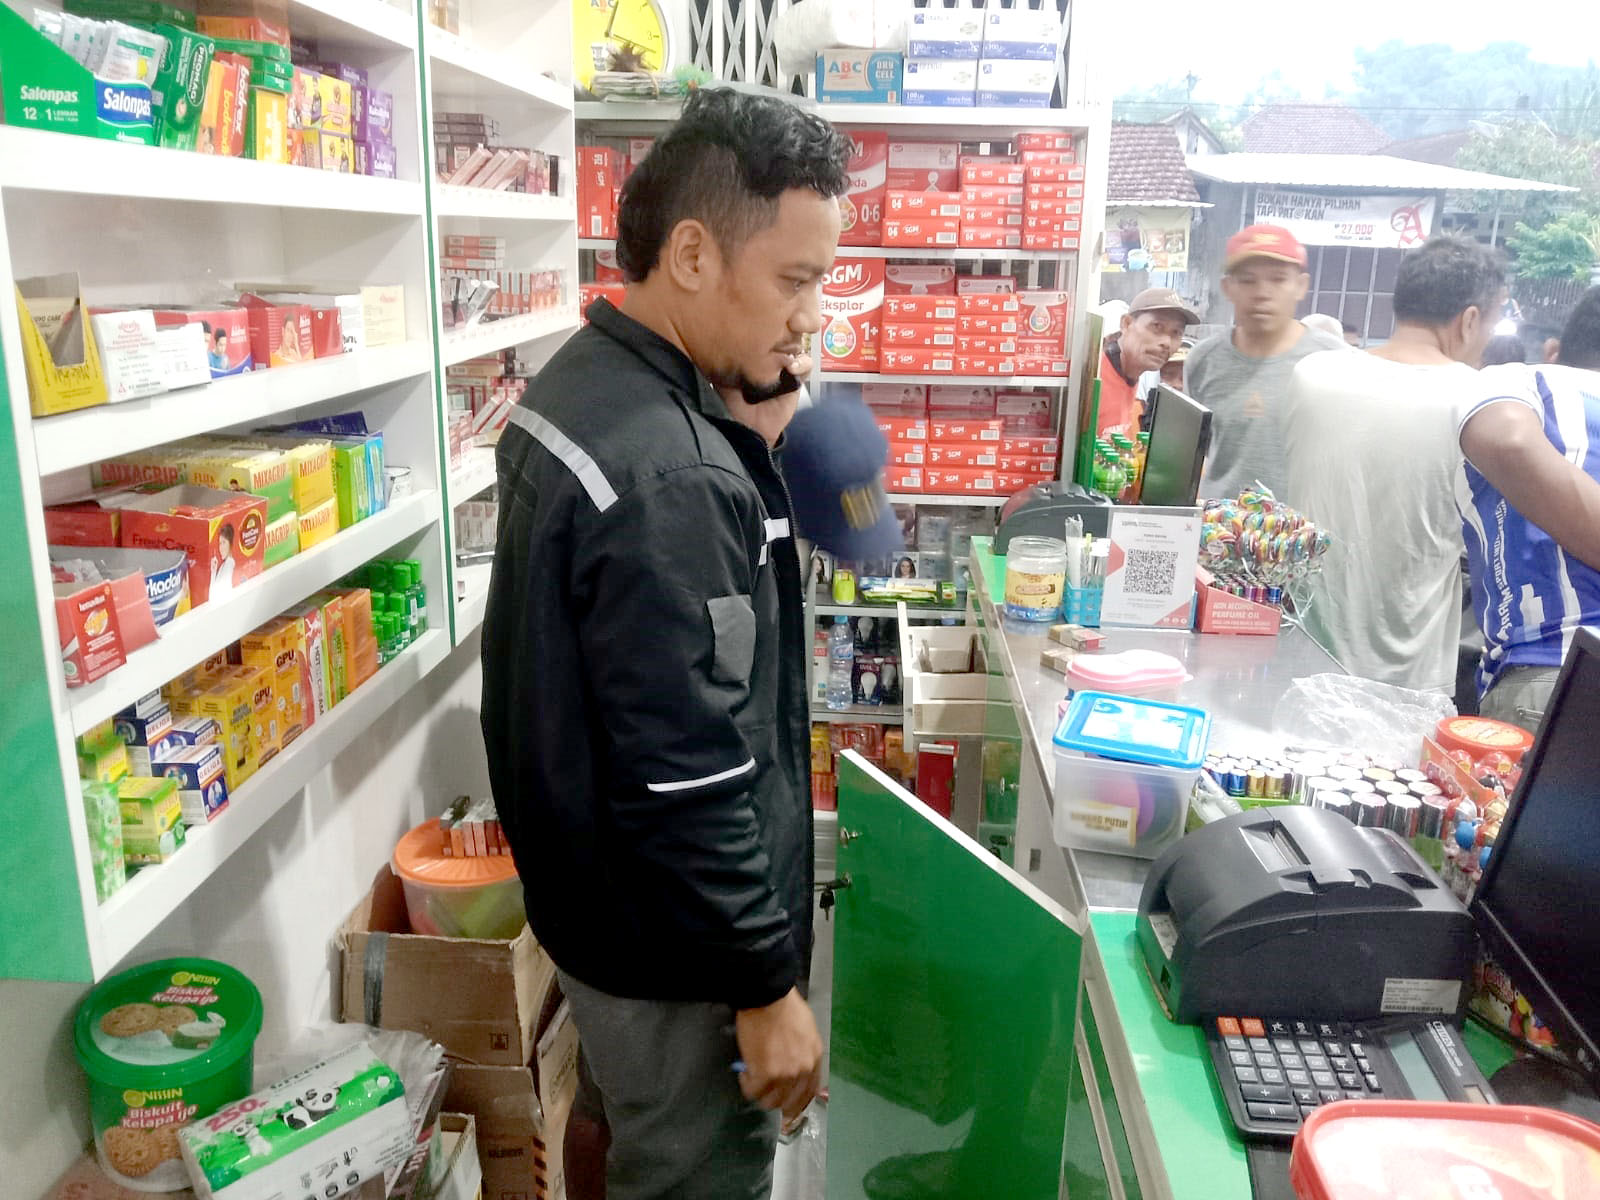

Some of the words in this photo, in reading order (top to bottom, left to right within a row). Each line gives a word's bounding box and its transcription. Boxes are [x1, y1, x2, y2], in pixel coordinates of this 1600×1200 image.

[829, 61, 862, 73] ABC
[20, 85, 79, 104] Salonpas
[104, 88, 151, 118] Salonpas
[235, 65, 249, 135] bodrex
[23, 107, 37, 120] 12
[908, 197, 923, 206] SGM
[1257, 192, 1288, 205] BUKAN
[1291, 195, 1322, 207] HANYA
[1324, 199, 1361, 209] PILIHAN
[1256, 205, 1275, 217] TAPI
[821, 263, 862, 285] SGM
[821, 300, 865, 312] Eksplor
[860, 321, 879, 341] 1+
[299, 452, 328, 478] MIXAGRIP
[101, 463, 177, 486] MIXAGRIP
[253, 463, 287, 490] MIXAGRIP
[300, 509, 331, 533] MIXAGRIP
[265, 524, 290, 549] IXAGRIP
[145, 571, 181, 598] rkadan
[205, 654, 222, 672] GPU
[276, 649, 295, 667] GPU
[254, 687, 270, 704] GPU
[199, 759, 221, 778] GELIGA
[1104, 817, 1128, 829] PUTIH
[152, 993, 199, 1005] Kelapa
[166, 986, 212, 995] Biskuit
[143, 1088, 183, 1100] NISSIN
[129, 1101, 185, 1119] Biskuit
[122, 1114, 175, 1128] Kelapa
